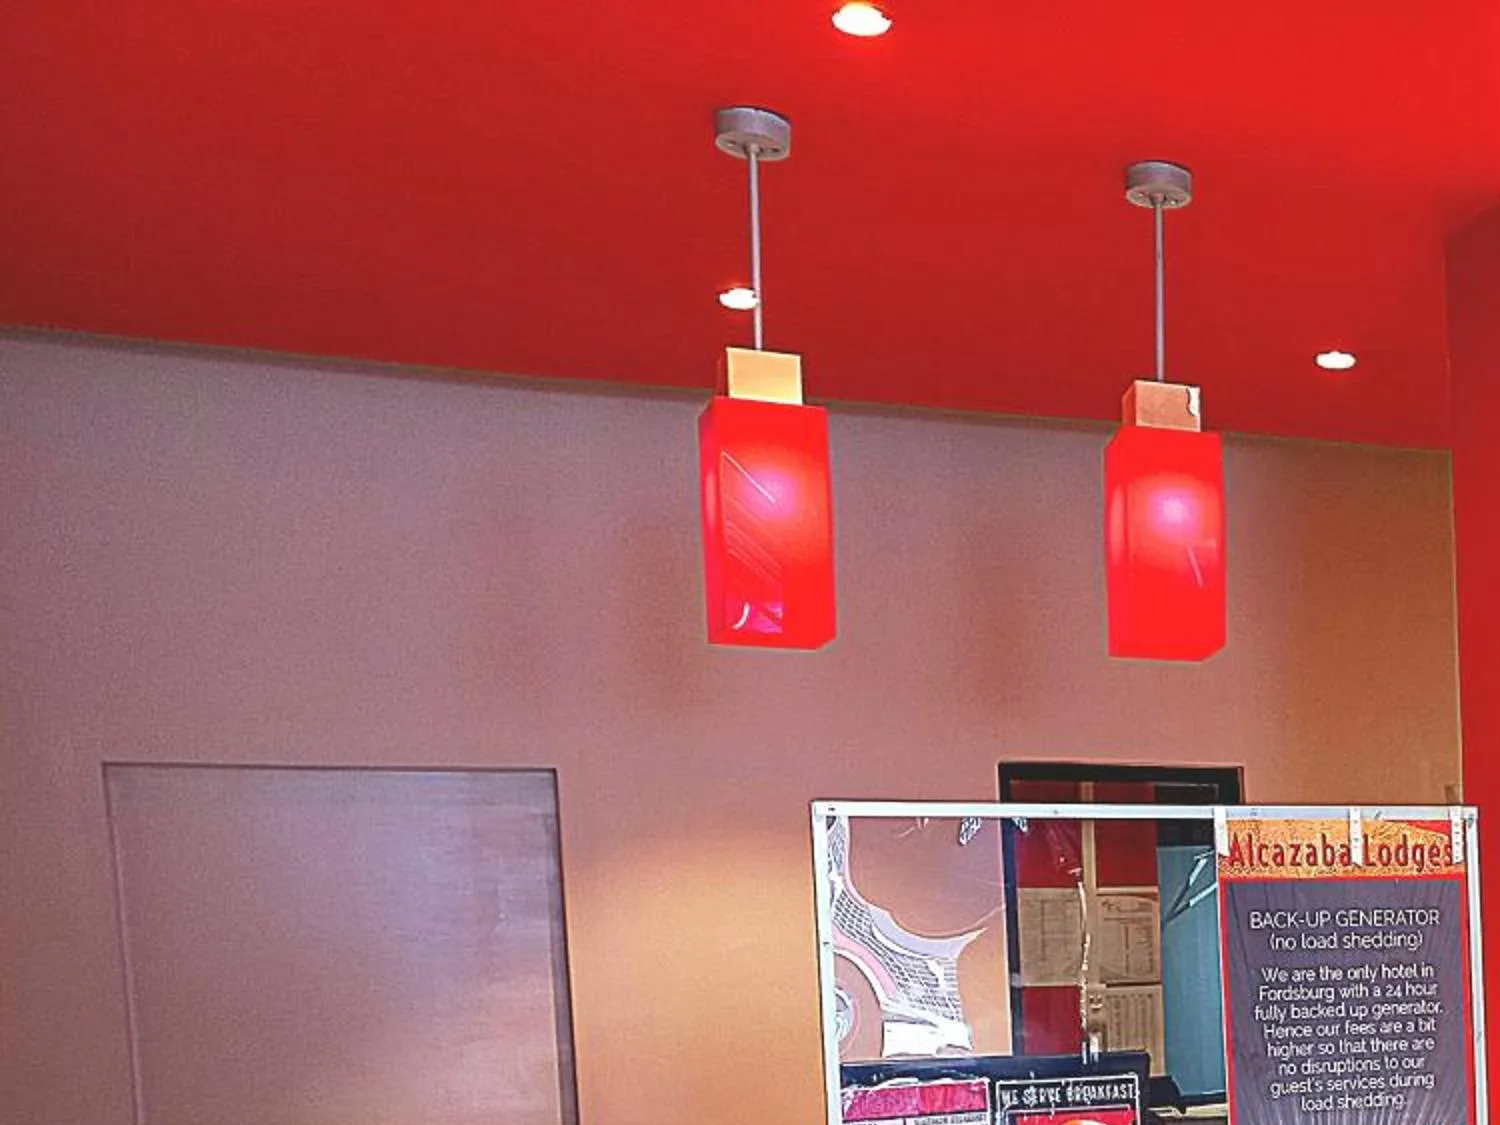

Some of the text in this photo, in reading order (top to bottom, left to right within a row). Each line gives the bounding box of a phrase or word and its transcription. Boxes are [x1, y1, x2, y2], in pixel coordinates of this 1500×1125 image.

[1228, 832, 1453, 872] Alcazaba Lodges
[1250, 909, 1440, 929] BACK-UP GENERATOR
[1270, 930, 1423, 951] (no load shedding)
[1261, 962, 1434, 983] We are the only hotel in
[1259, 981, 1438, 1003] Fordsburg with a 24 hour
[1254, 1000, 1443, 1023] fully backed up generator.
[1263, 1017, 1437, 1040] Hence our fees are a bit
[1267, 1037, 1435, 1060] higher so that there are
[1279, 1055, 1425, 1077] no disruptions to our
[1270, 1071, 1434, 1098] guest's services during
[1301, 1096, 1333, 1111] load
